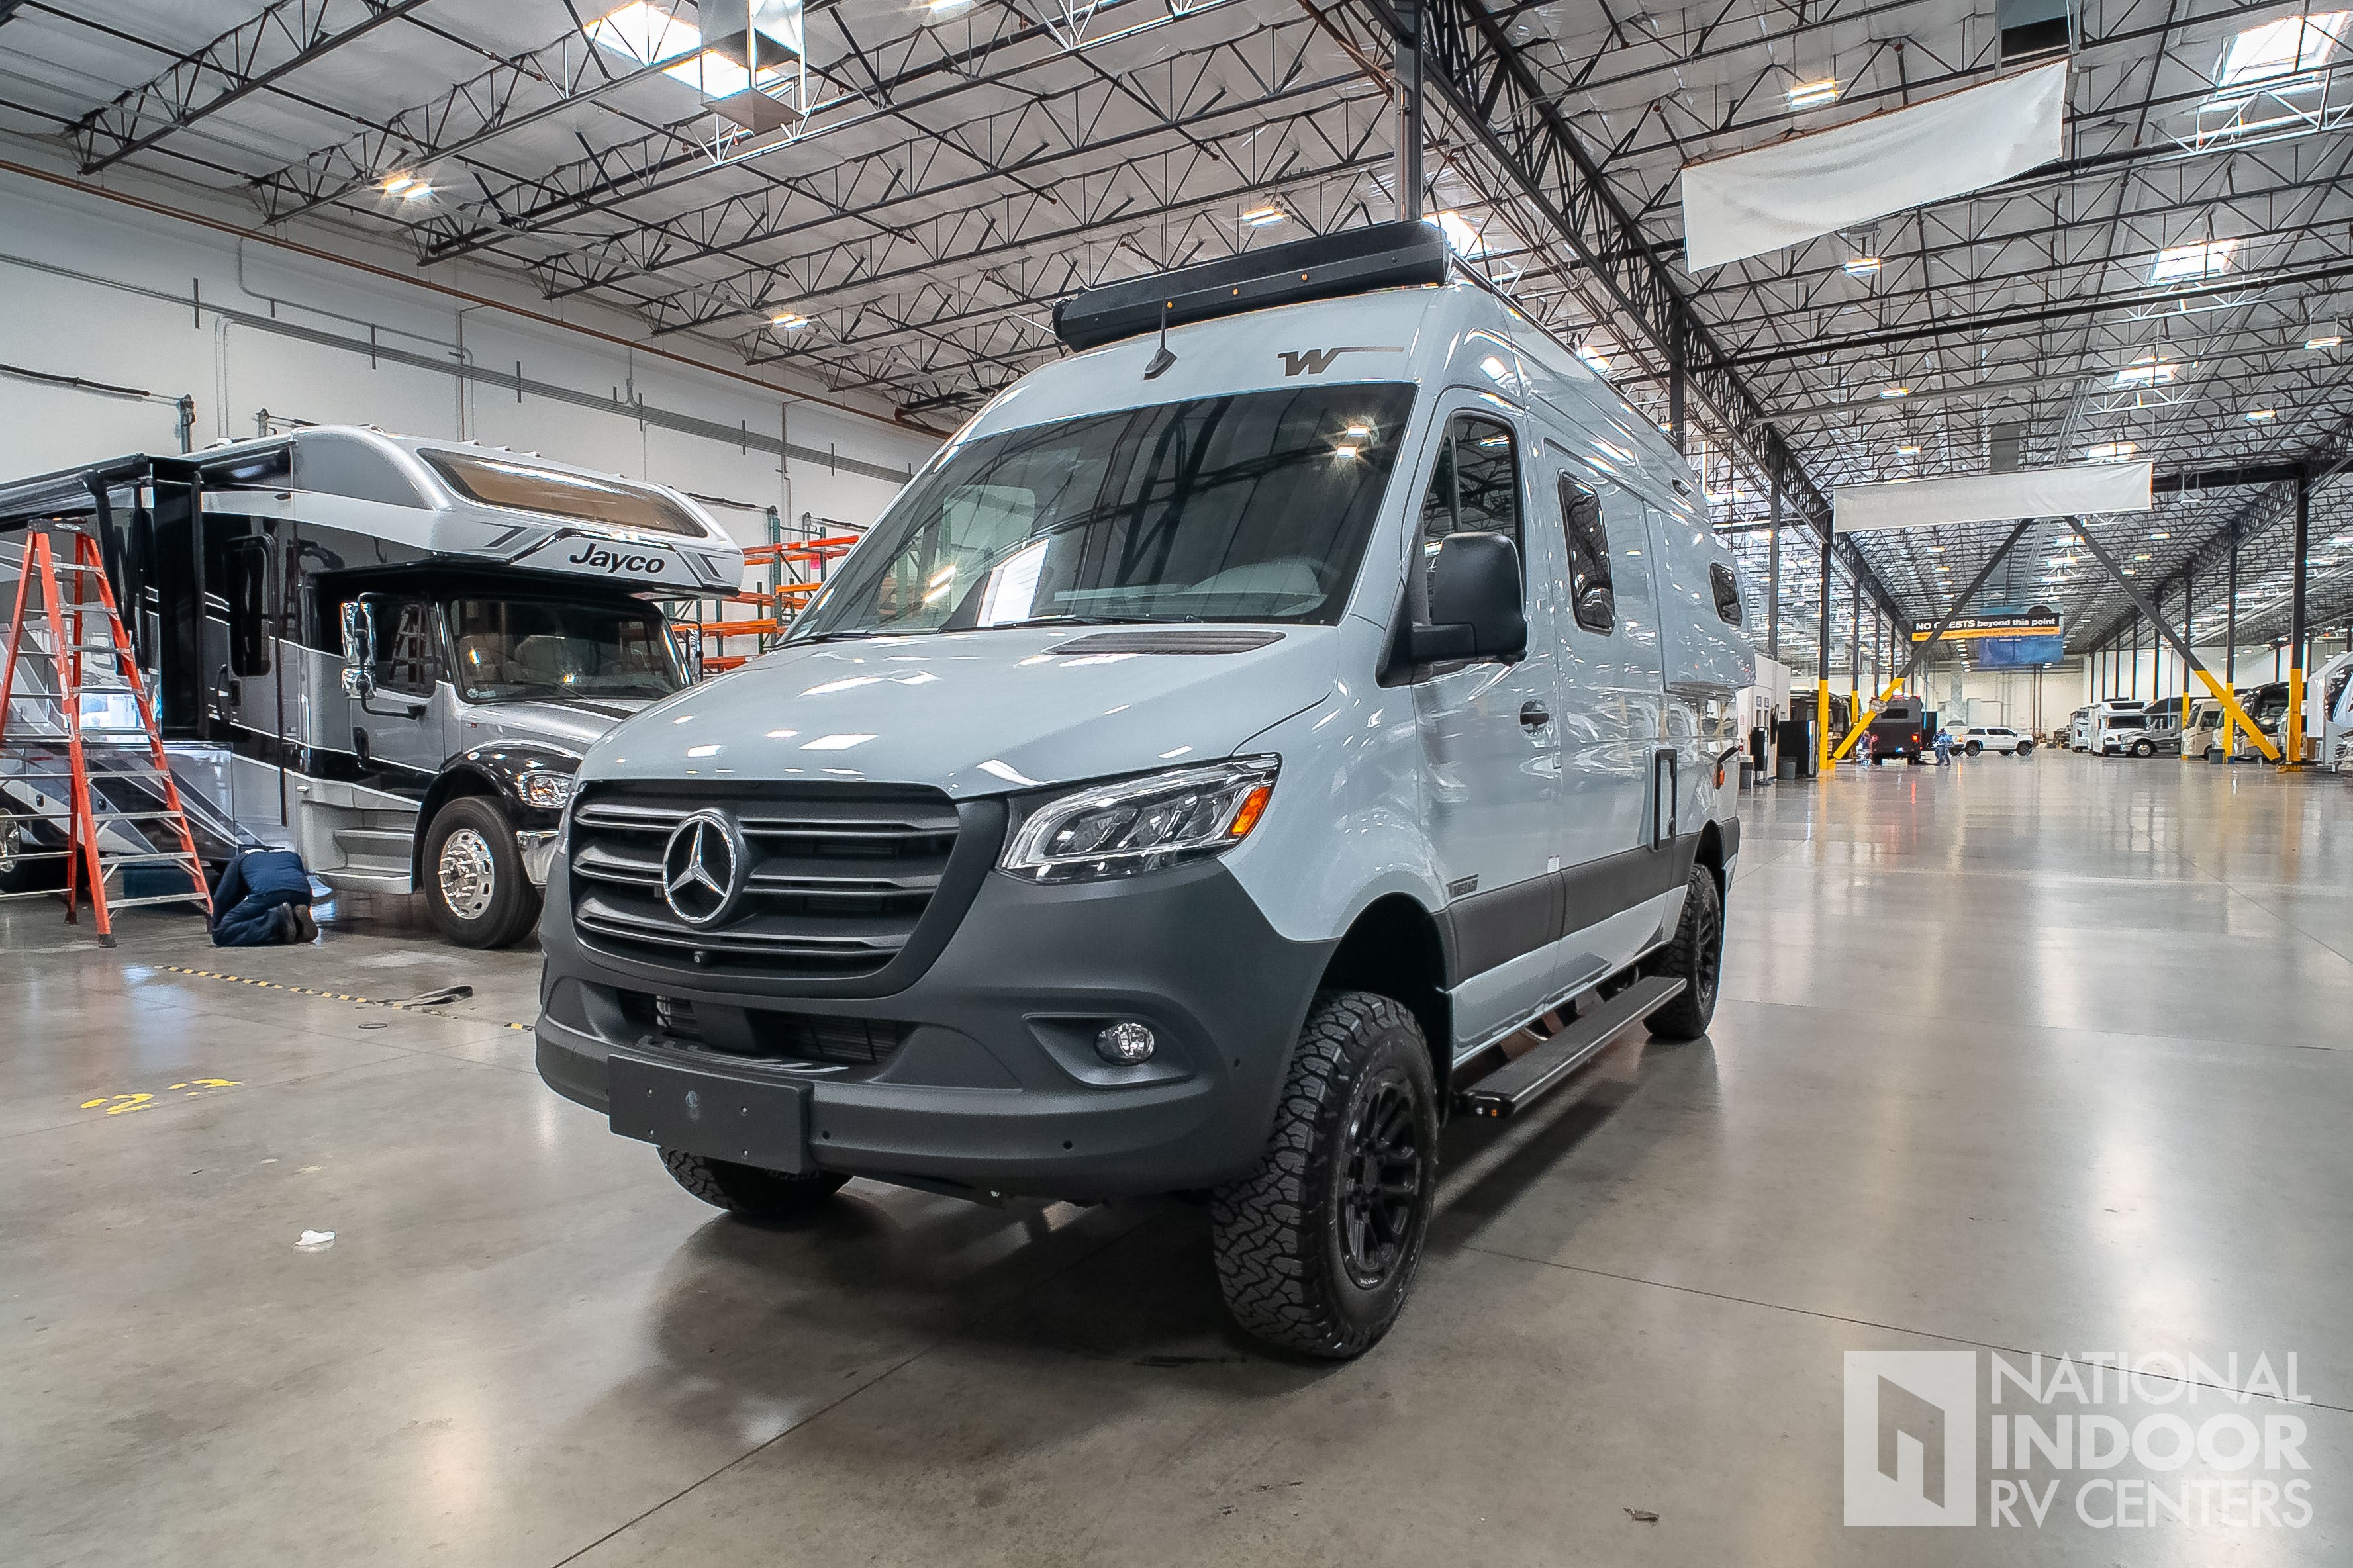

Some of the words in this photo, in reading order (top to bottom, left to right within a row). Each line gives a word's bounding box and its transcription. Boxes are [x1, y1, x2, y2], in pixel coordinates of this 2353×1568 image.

[569, 543, 665, 574] Jayco
[1915, 622, 1932, 631] NO
[1934, 620, 1976, 629] ESTS
[1977, 619, 2011, 627] beyond
[2031, 618, 2056, 627] point
